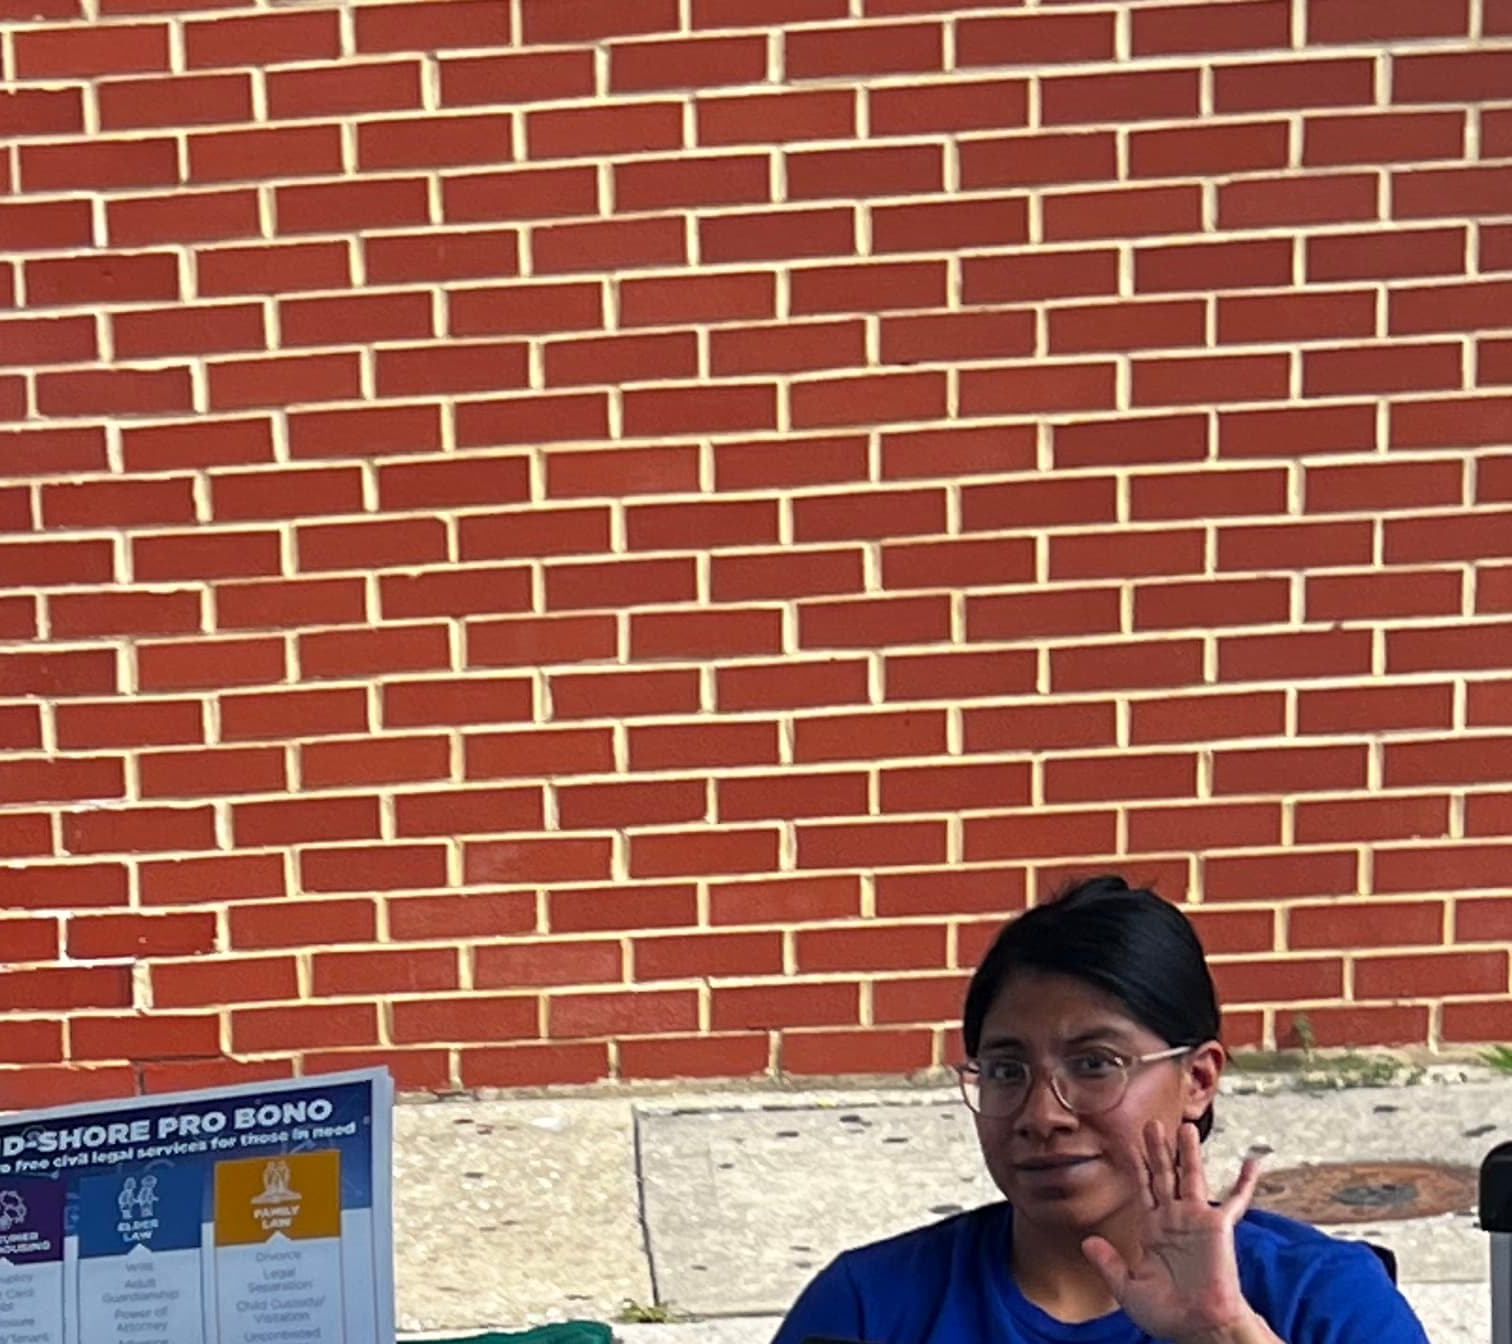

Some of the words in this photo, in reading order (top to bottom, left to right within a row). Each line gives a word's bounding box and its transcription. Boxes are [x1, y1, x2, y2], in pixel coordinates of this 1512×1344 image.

[157, 1111, 227, 1140] PRO
[234, 1099, 333, 1130] BONO
[15, 1158, 50, 1173] free
[53, 1151, 88, 1168] civil
[91, 1149, 133, 1165] legal
[137, 1138, 208, 1159] services
[211, 1135, 237, 1149] for
[240, 1131, 288, 1147] those
[292, 1127, 309, 1141] in
[312, 1121, 357, 1140] need
[123, 1231, 153, 1243] LAW
[262, 1217, 292, 1231] LAW
